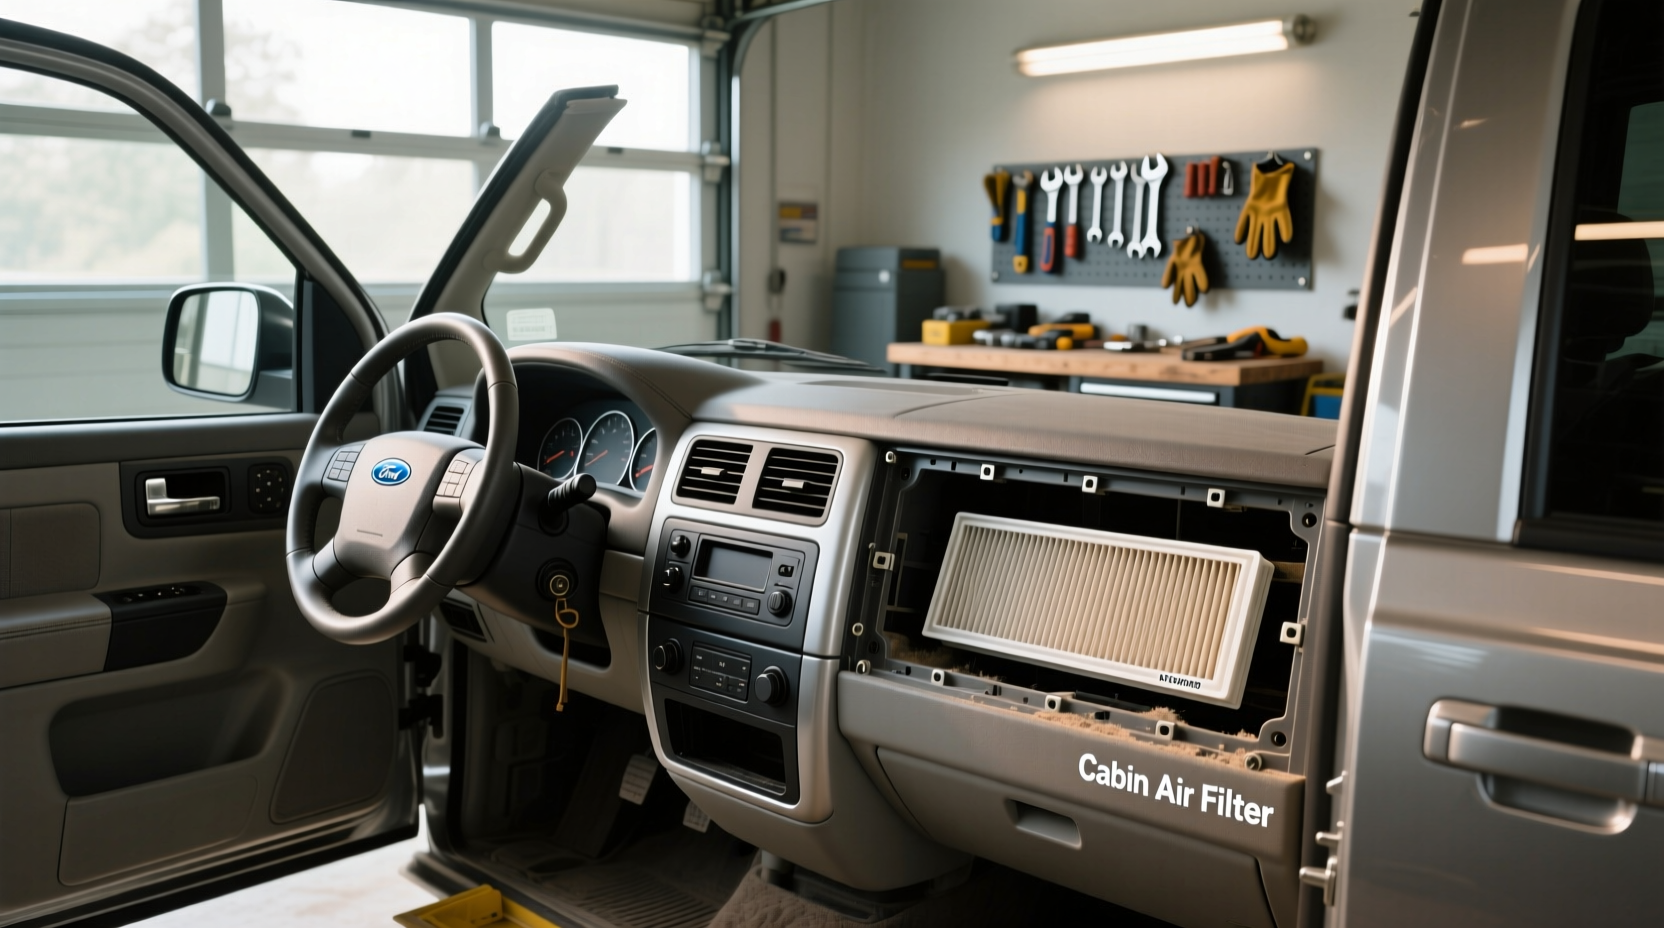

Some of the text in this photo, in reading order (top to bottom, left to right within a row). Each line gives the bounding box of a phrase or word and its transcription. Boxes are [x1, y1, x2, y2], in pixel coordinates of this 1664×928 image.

[1078, 753, 1274, 828] Cabin Air Filter
